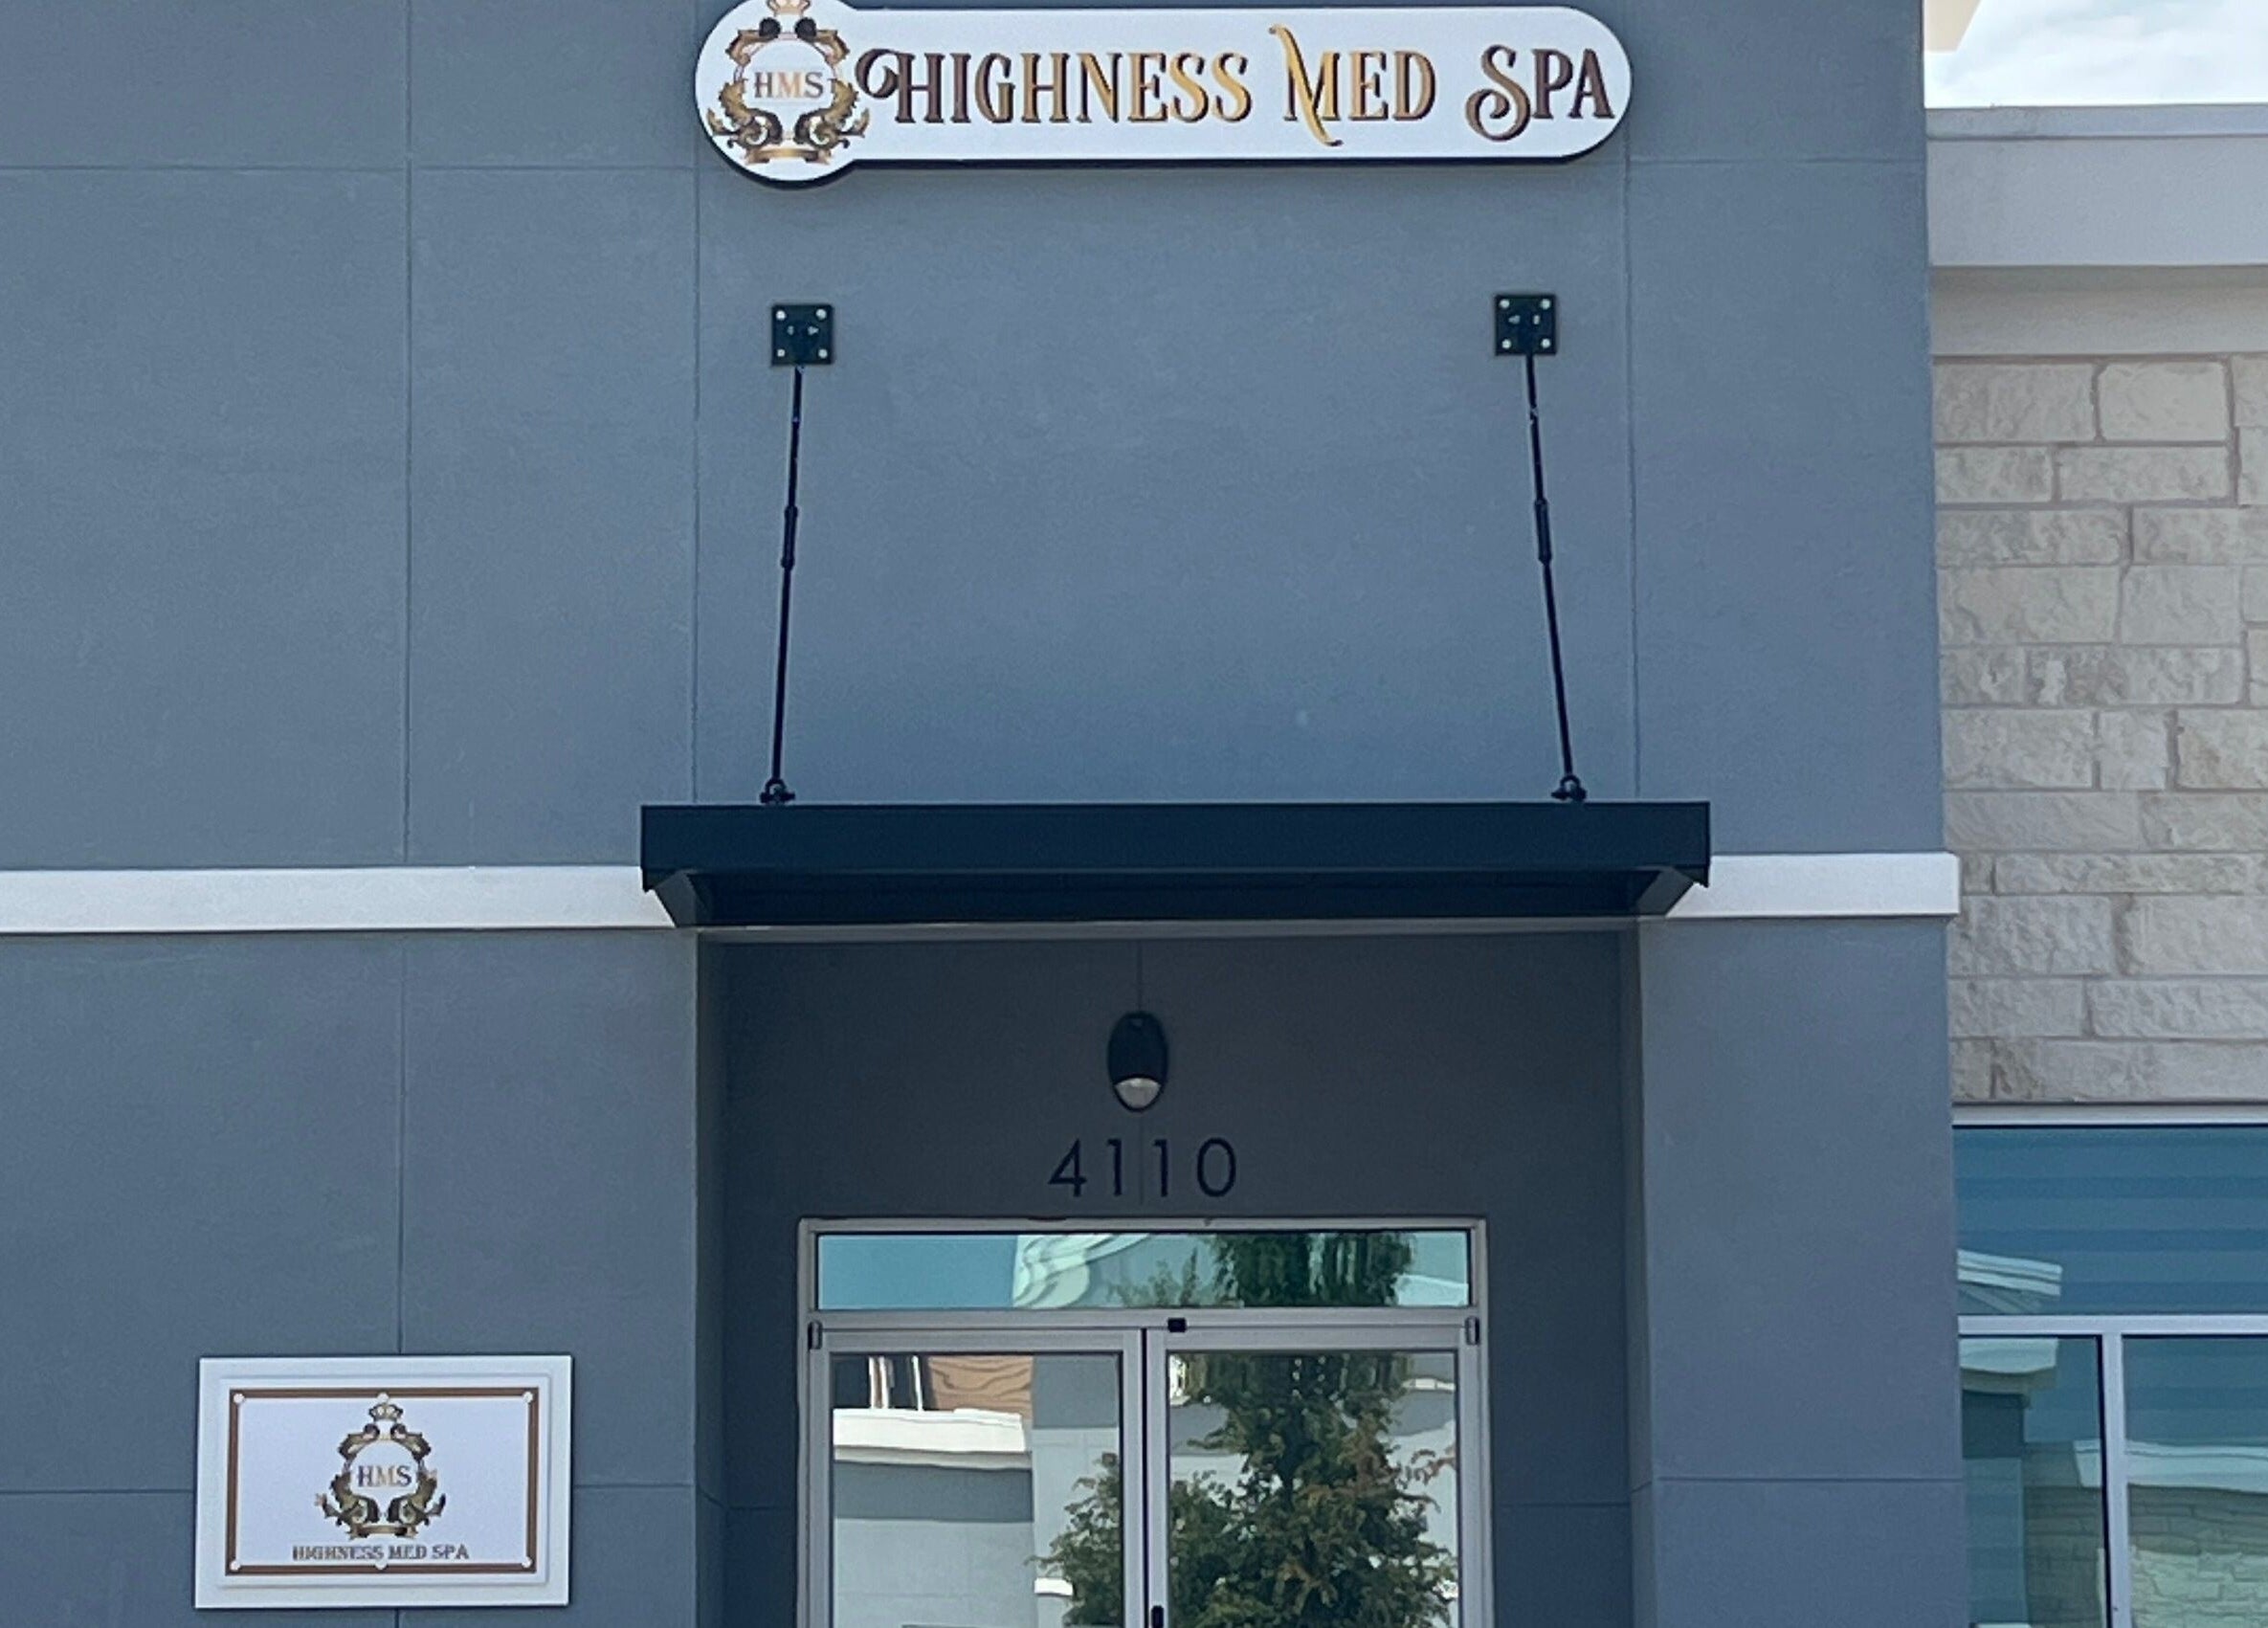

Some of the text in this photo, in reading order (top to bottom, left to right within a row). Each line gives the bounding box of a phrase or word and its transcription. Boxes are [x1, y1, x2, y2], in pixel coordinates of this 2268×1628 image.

[753, 71, 824, 99] HMS
[855, 23, 1615, 146] HIGHNESS MED SPA
[1048, 1137, 1236, 1196] 4110
[357, 1464, 412, 1487] HMS
[292, 1544, 470, 1561] HIGHNESS MED SPA
